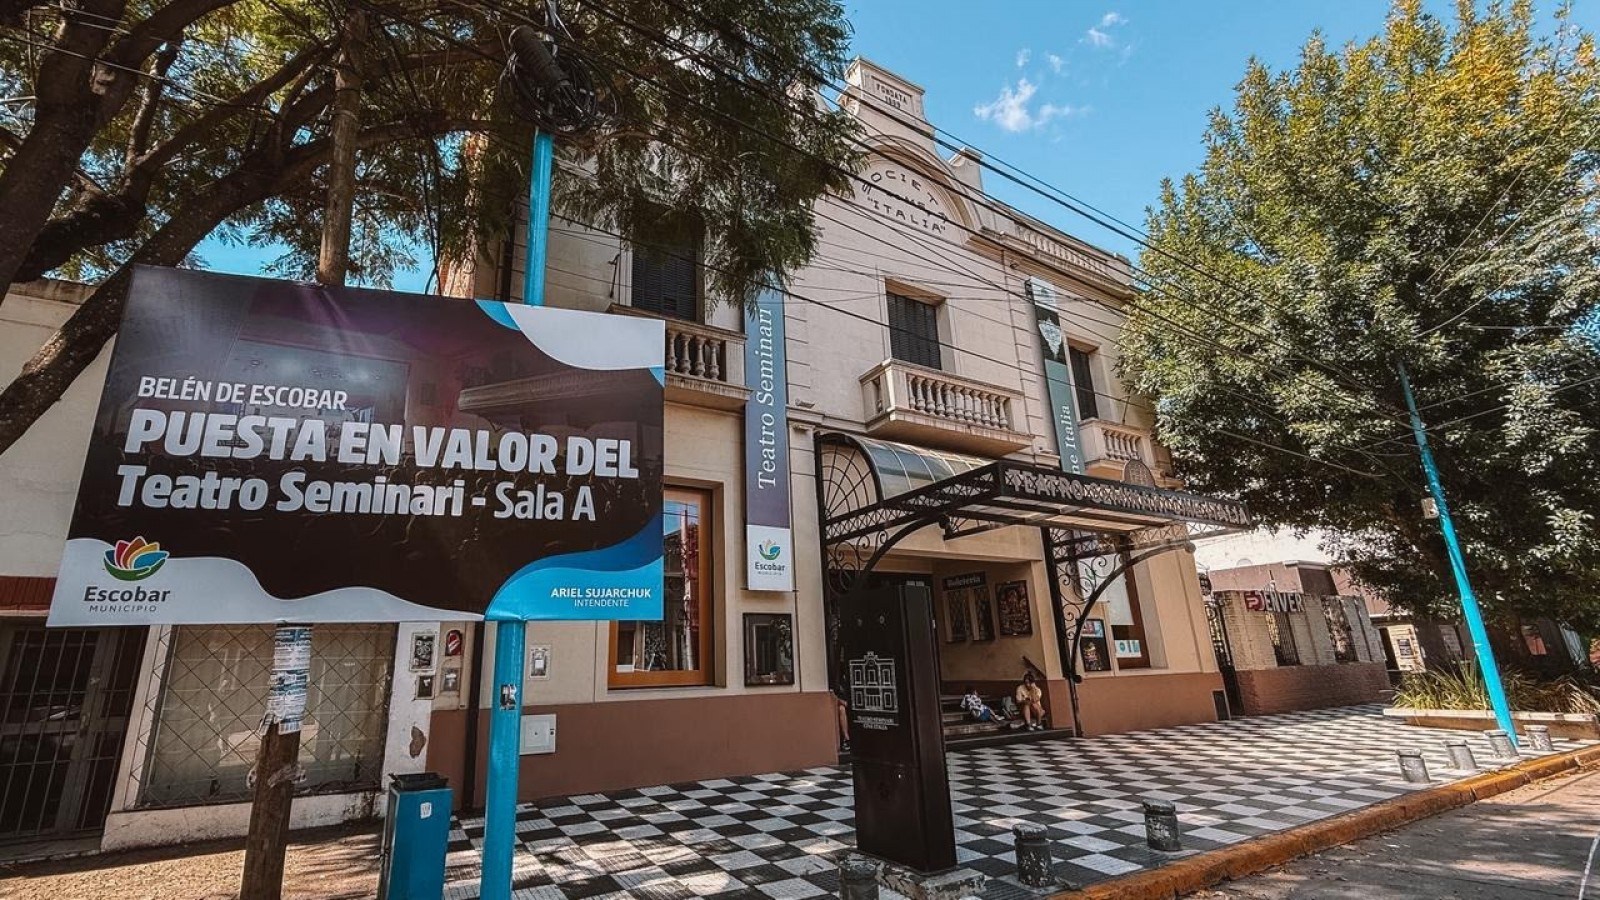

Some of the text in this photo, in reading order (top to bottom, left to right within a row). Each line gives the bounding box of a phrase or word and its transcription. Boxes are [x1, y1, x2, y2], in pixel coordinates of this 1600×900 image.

[138, 376, 348, 411] BELÉN DE ESCOBAR
[755, 309, 776, 489] Teatro Seminari
[1060, 405, 1077, 449] Italia
[124, 408, 639, 478] PUESTA EN VALOR DEL
[117, 464, 268, 511] Teatro
[276, 471, 465, 516] Seminari
[494, 481, 564, 520] Sala
[571, 486, 596, 521] A
[1008, 469, 1084, 500] TEATRO
[755, 562, 785, 571] Escobar
[84, 586, 171, 602] Escobar
[89, 604, 157, 612] MUNICIPIO
[551, 588, 651, 598] ARIEL SUJARCHUK
[574, 599, 629, 607] INTENDENTE
